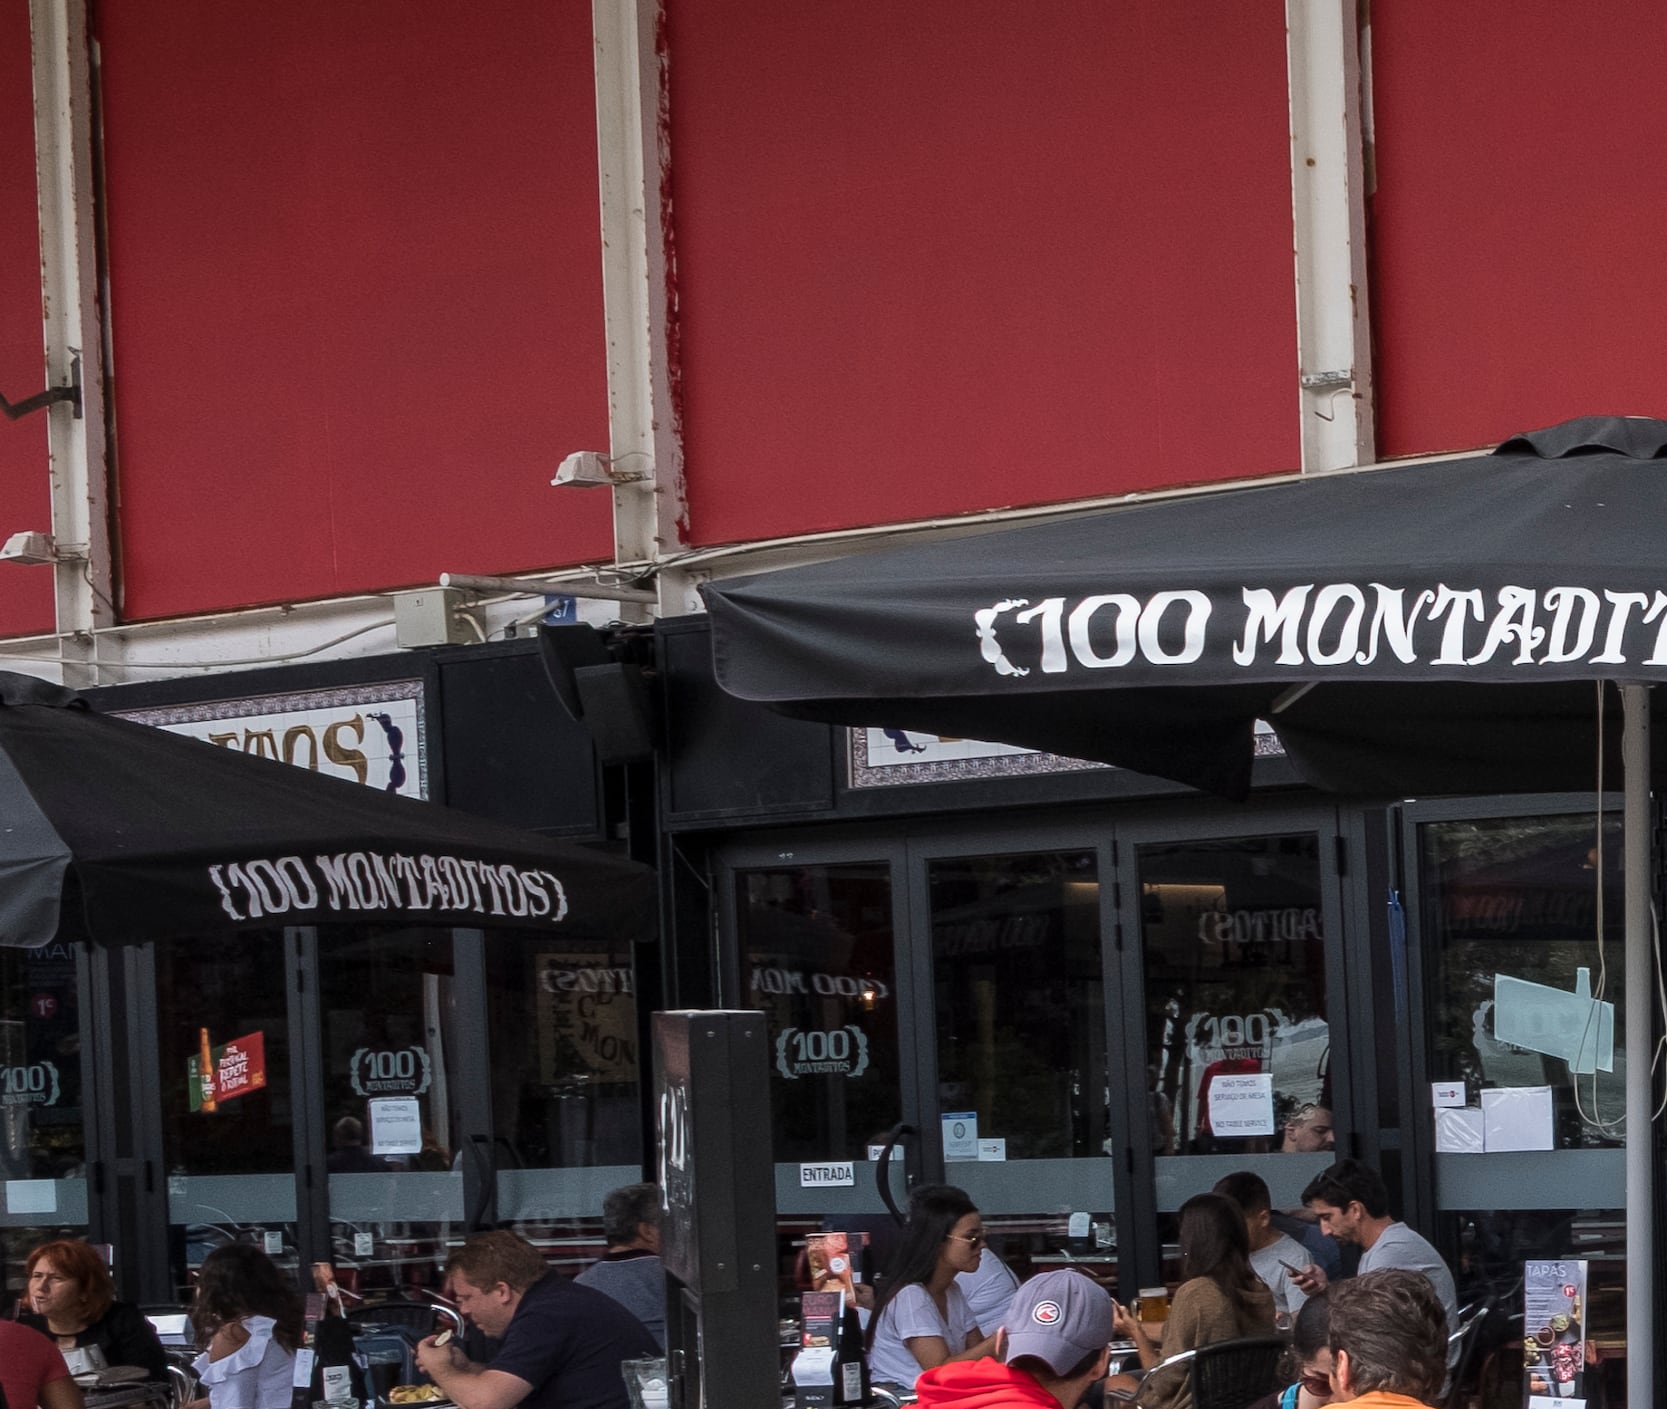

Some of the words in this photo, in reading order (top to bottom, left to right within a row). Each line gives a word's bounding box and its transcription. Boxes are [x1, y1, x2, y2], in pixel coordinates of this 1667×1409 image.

[1018, 590, 1213, 674] 100
[233, 856, 317, 911] 100
[316, 851, 550, 917] MONTADITOS
[793, 1030, 849, 1061] 100
[364, 1050, 415, 1079] 100
[802, 1167, 853, 1182] ENTRADA
[1527, 1264, 1567, 1278] TAPAS
